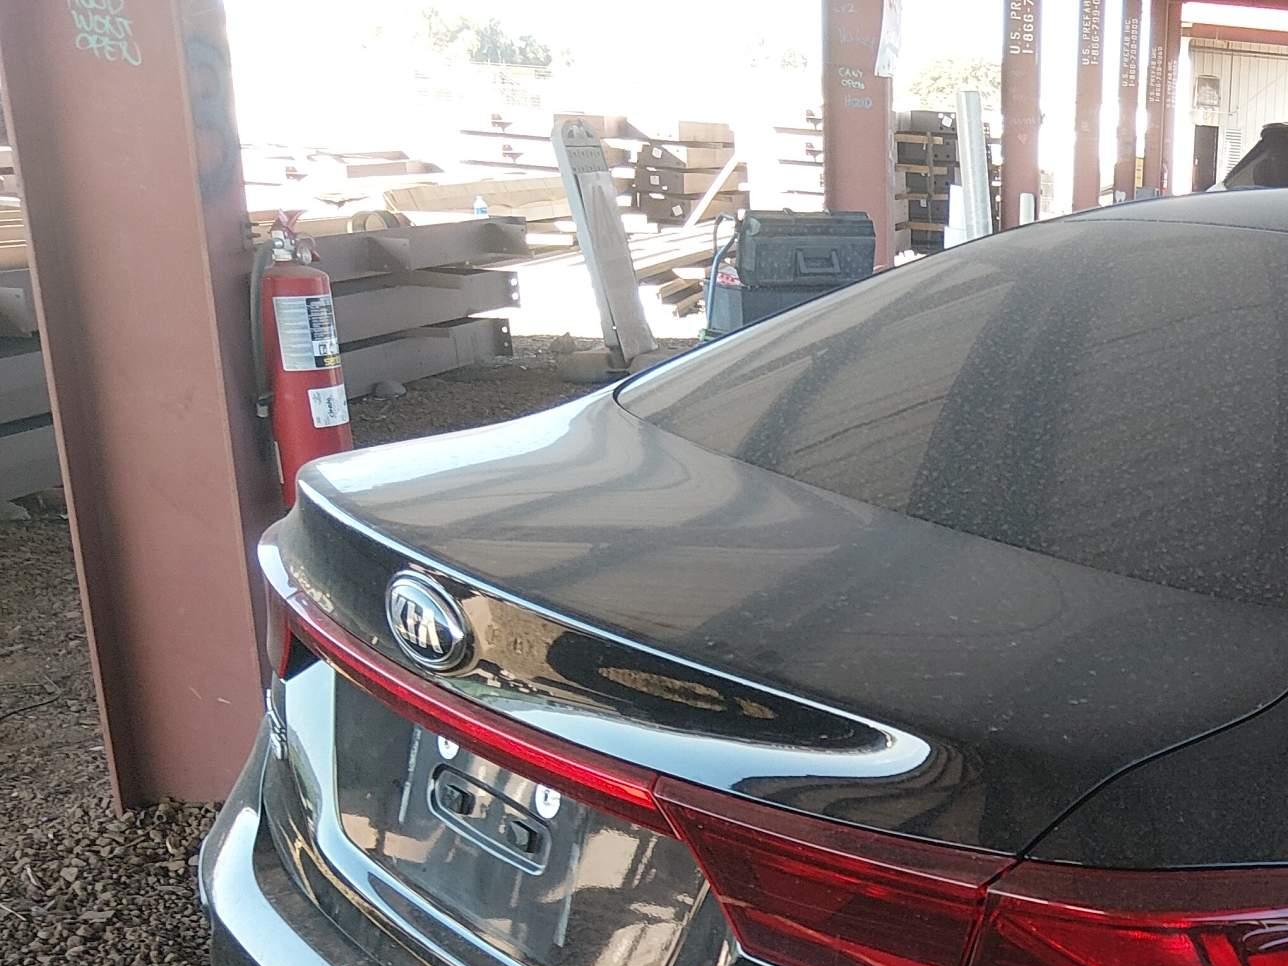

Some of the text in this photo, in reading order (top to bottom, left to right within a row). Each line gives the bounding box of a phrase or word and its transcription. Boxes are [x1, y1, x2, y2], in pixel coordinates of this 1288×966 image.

[1010, 0, 1022, 54] U.S. PR
[1081, 45, 1090, 65] U.S.
